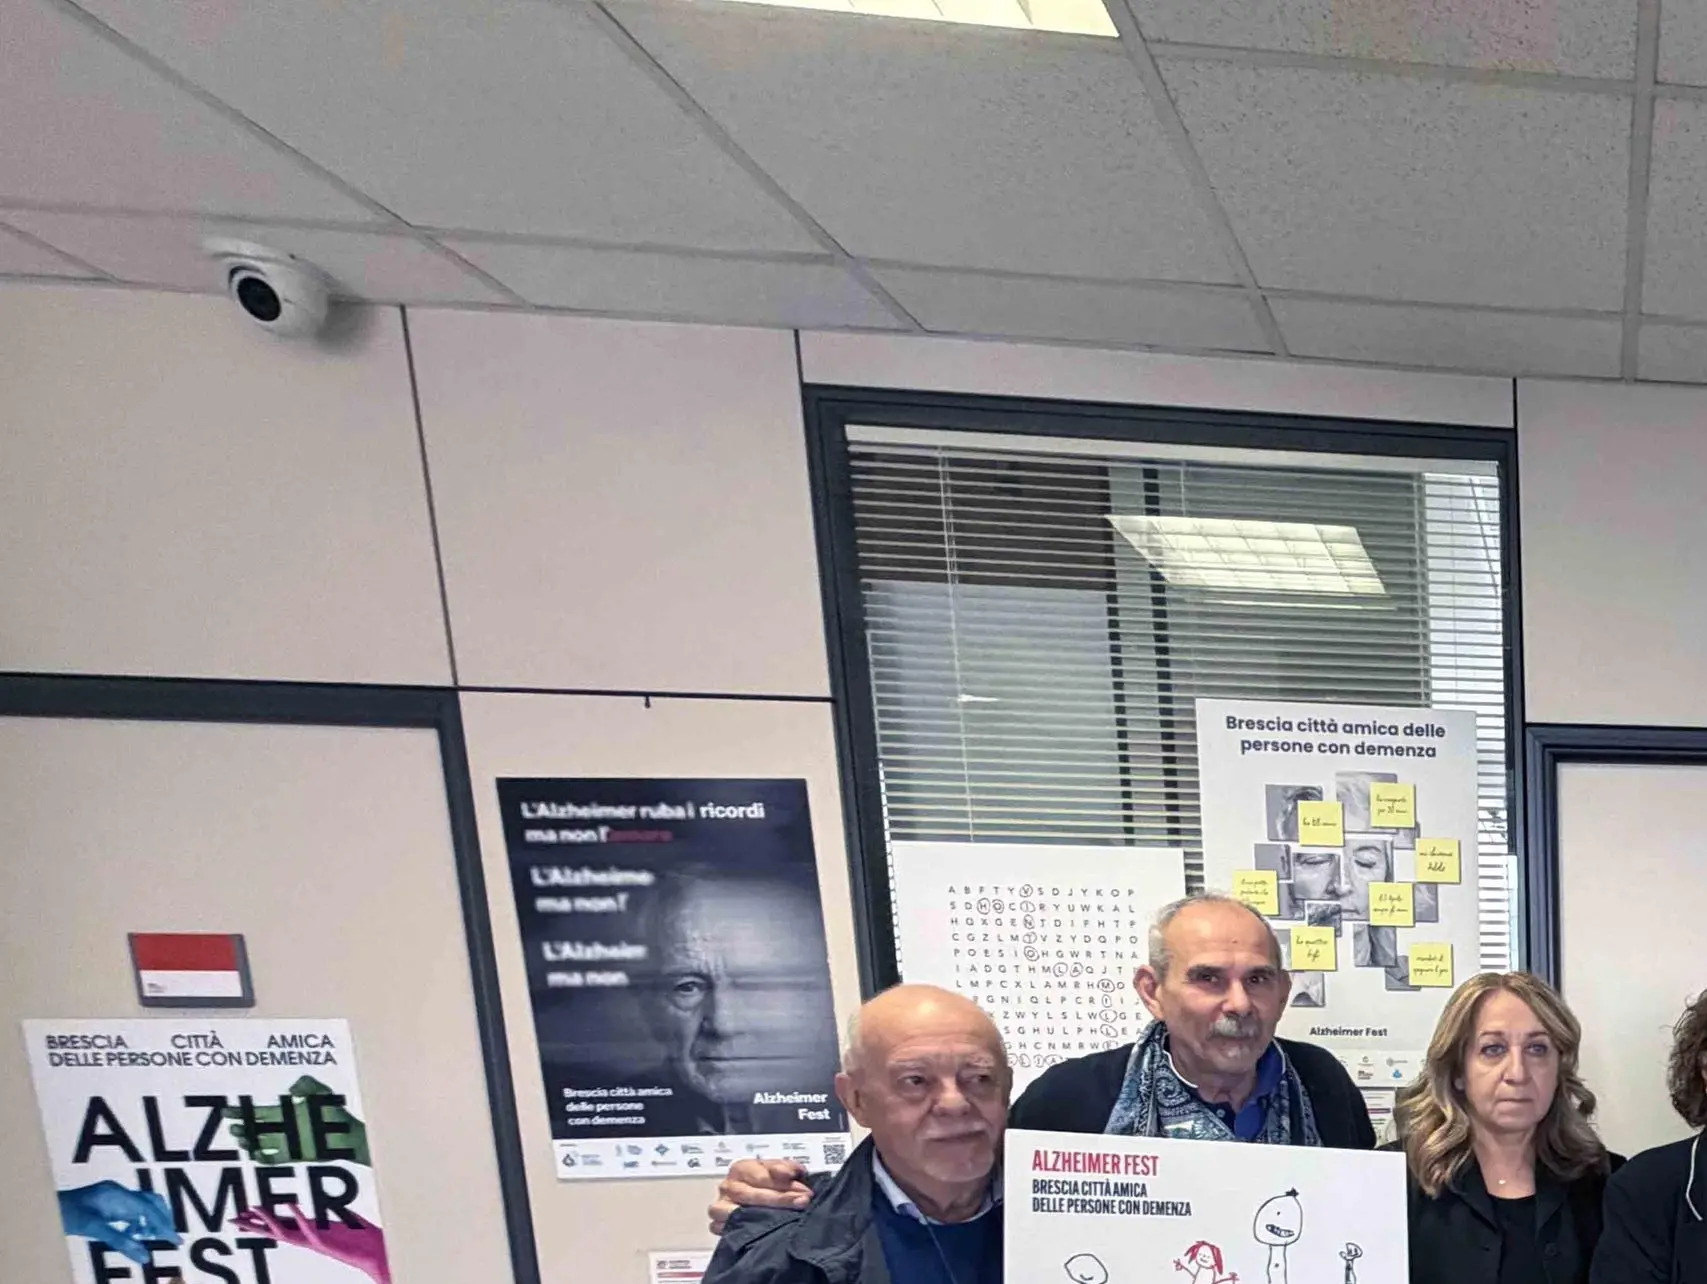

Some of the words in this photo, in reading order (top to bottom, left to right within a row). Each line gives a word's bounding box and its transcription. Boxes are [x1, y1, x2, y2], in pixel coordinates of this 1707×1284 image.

[1226, 716, 1293, 732] Brescia
[1297, 718, 1338, 733] città
[1342, 721, 1399, 736] amica
[1403, 723, 1446, 738] delle
[1240, 739, 1314, 755] persone
[1317, 741, 1351, 755] con
[1354, 742, 1437, 758] demenza
[520, 801, 636, 819] L'Alzheimer
[639, 802, 686, 819] ruba
[700, 802, 765, 819] ricordi
[525, 829, 557, 842] ma
[559, 829, 598, 842] non
[535, 897, 572, 913] ma
[574, 897, 617, 913] non
[547, 972, 583, 986] ma
[1310, 1026, 1363, 1037] Alzheimer
[1365, 1027, 1388, 1037] Fest
[46, 1034, 128, 1050] BRESCIA
[171, 1030, 224, 1050] CITTÀ
[266, 1034, 335, 1049] AMICA
[50, 1052, 104, 1067] DELLE
[106, 1051, 193, 1067] PERSONE
[195, 1051, 243, 1067] CON
[245, 1051, 338, 1066] DEMENZA
[563, 1087, 609, 1098] Brescia
[609, 1086, 636, 1098] città
[637, 1085, 673, 1097] amica
[753, 1092, 828, 1105] Alzheimer
[566, 1100, 594, 1112] delle
[596, 1100, 644, 1114] persone
[798, 1107, 831, 1121] Fest
[568, 1115, 591, 1126] con
[591, 1114, 646, 1126] demenza
[72, 1094, 357, 1164] ALZHE
[1032, 1149, 1121, 1175] ALZHEIMER
[1124, 1154, 1158, 1176] FEST
[1032, 1179, 1080, 1197] BRESCIA
[1081, 1178, 1113, 1198] CITTÀ
[1113, 1181, 1148, 1198] AMICA
[1032, 1197, 1066, 1214] DELLE
[1067, 1198, 1116, 1215] PERSONE
[1118, 1199, 1141, 1216] CON
[1142, 1202, 1192, 1217] DEMENZA
